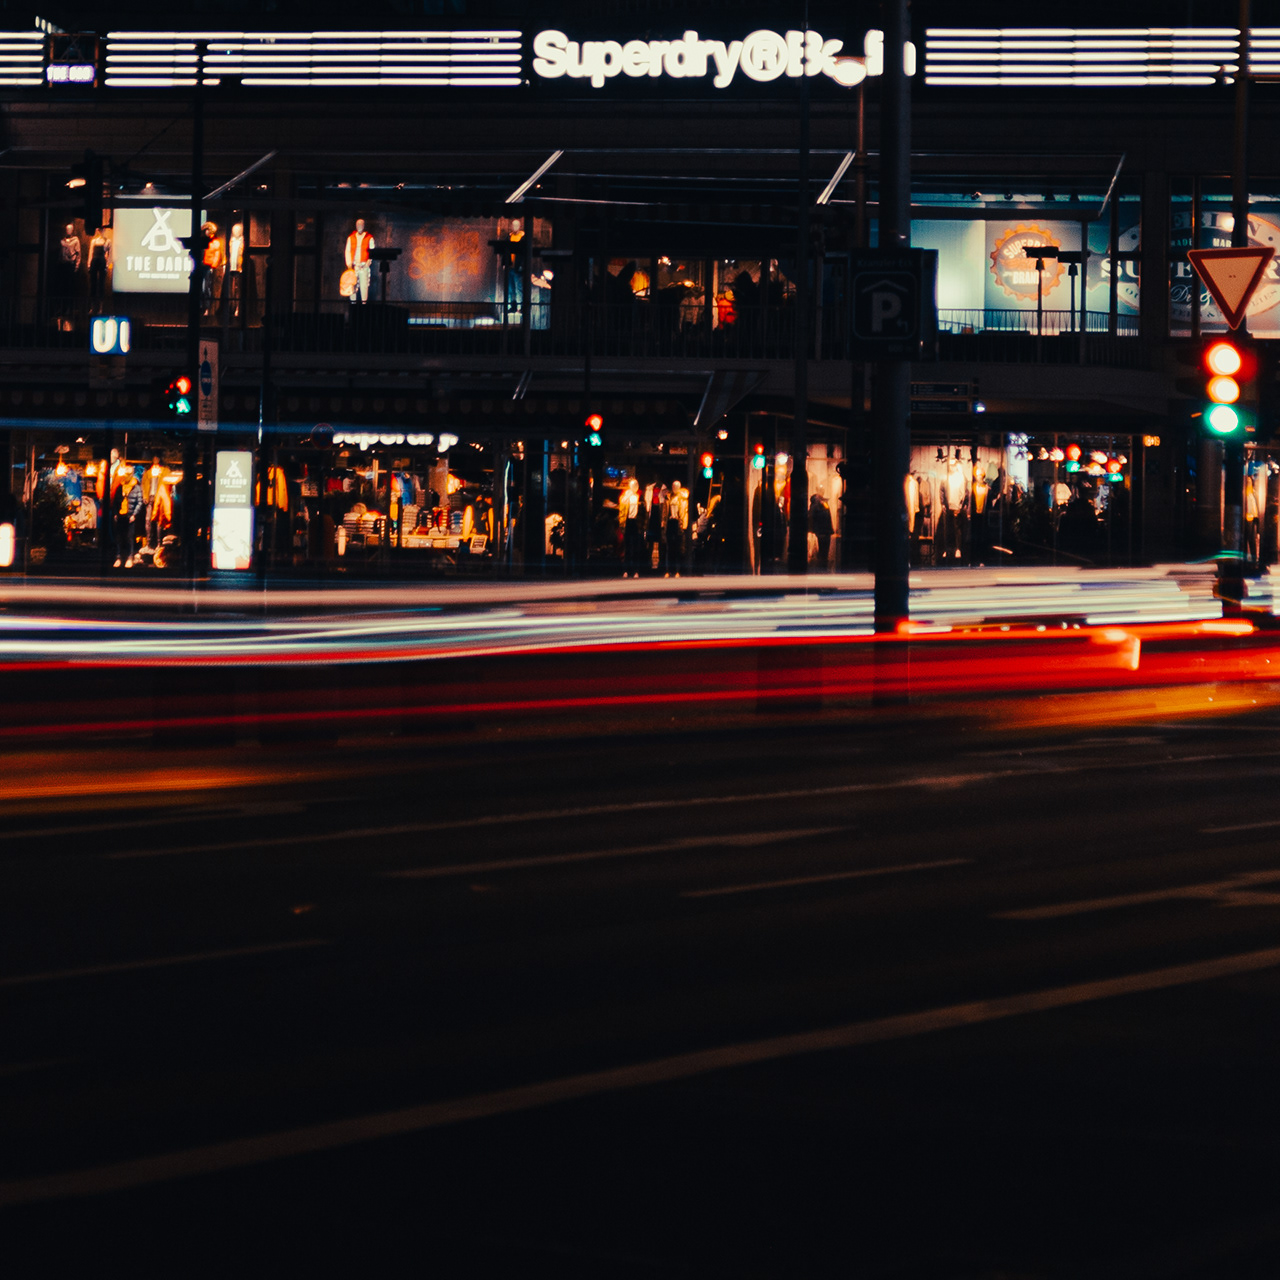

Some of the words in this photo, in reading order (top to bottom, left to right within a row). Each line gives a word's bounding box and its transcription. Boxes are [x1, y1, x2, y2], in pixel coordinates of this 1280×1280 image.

[1212, 237, 1232, 248] MAR
[126, 255, 151, 272] THE
[871, 291, 902, 333] P
